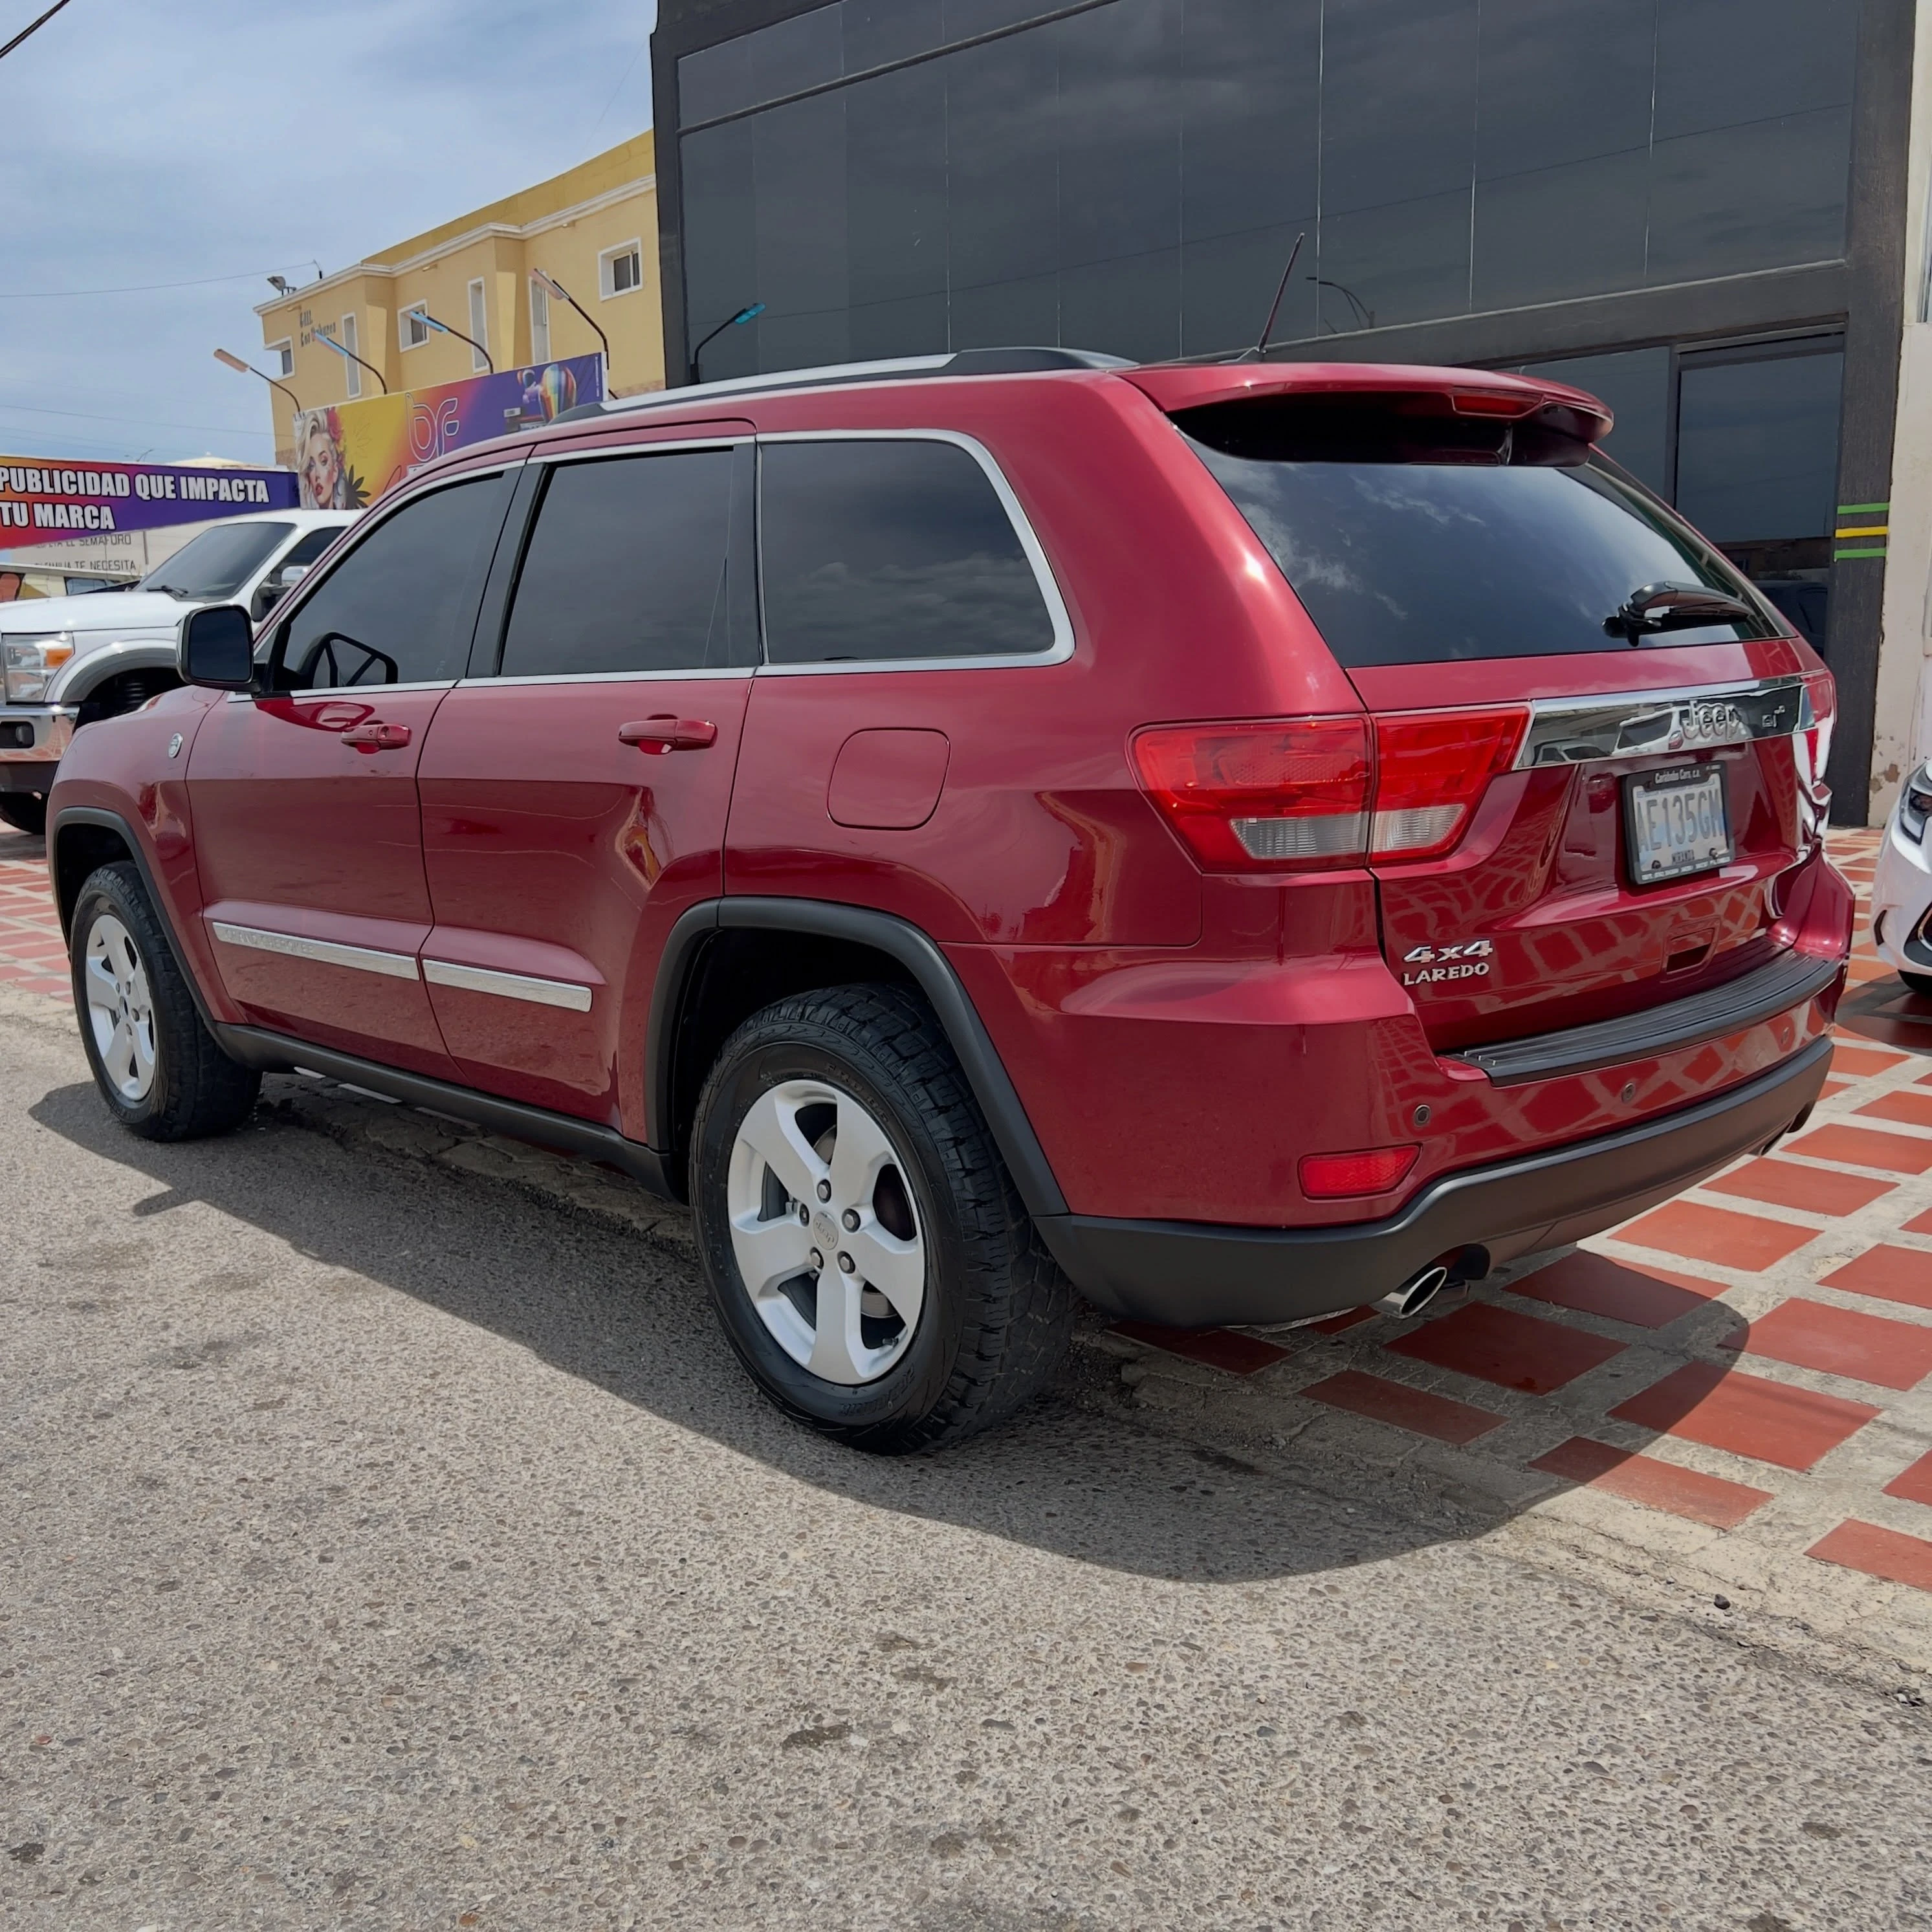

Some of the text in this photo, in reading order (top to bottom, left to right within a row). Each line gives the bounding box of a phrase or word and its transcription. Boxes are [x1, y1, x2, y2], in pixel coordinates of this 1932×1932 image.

[0, 466, 270, 503] PUBLICIDAD QUE IMPACTA
[0, 501, 116, 531] TU MARCA
[90, 560, 137, 571] NECESITA
[1682, 700, 1742, 741] Jeep
[1636, 789, 1724, 853] AE135GM
[1403, 939, 1493, 963] 4x4
[1403, 961, 1489, 986] LAREDO
